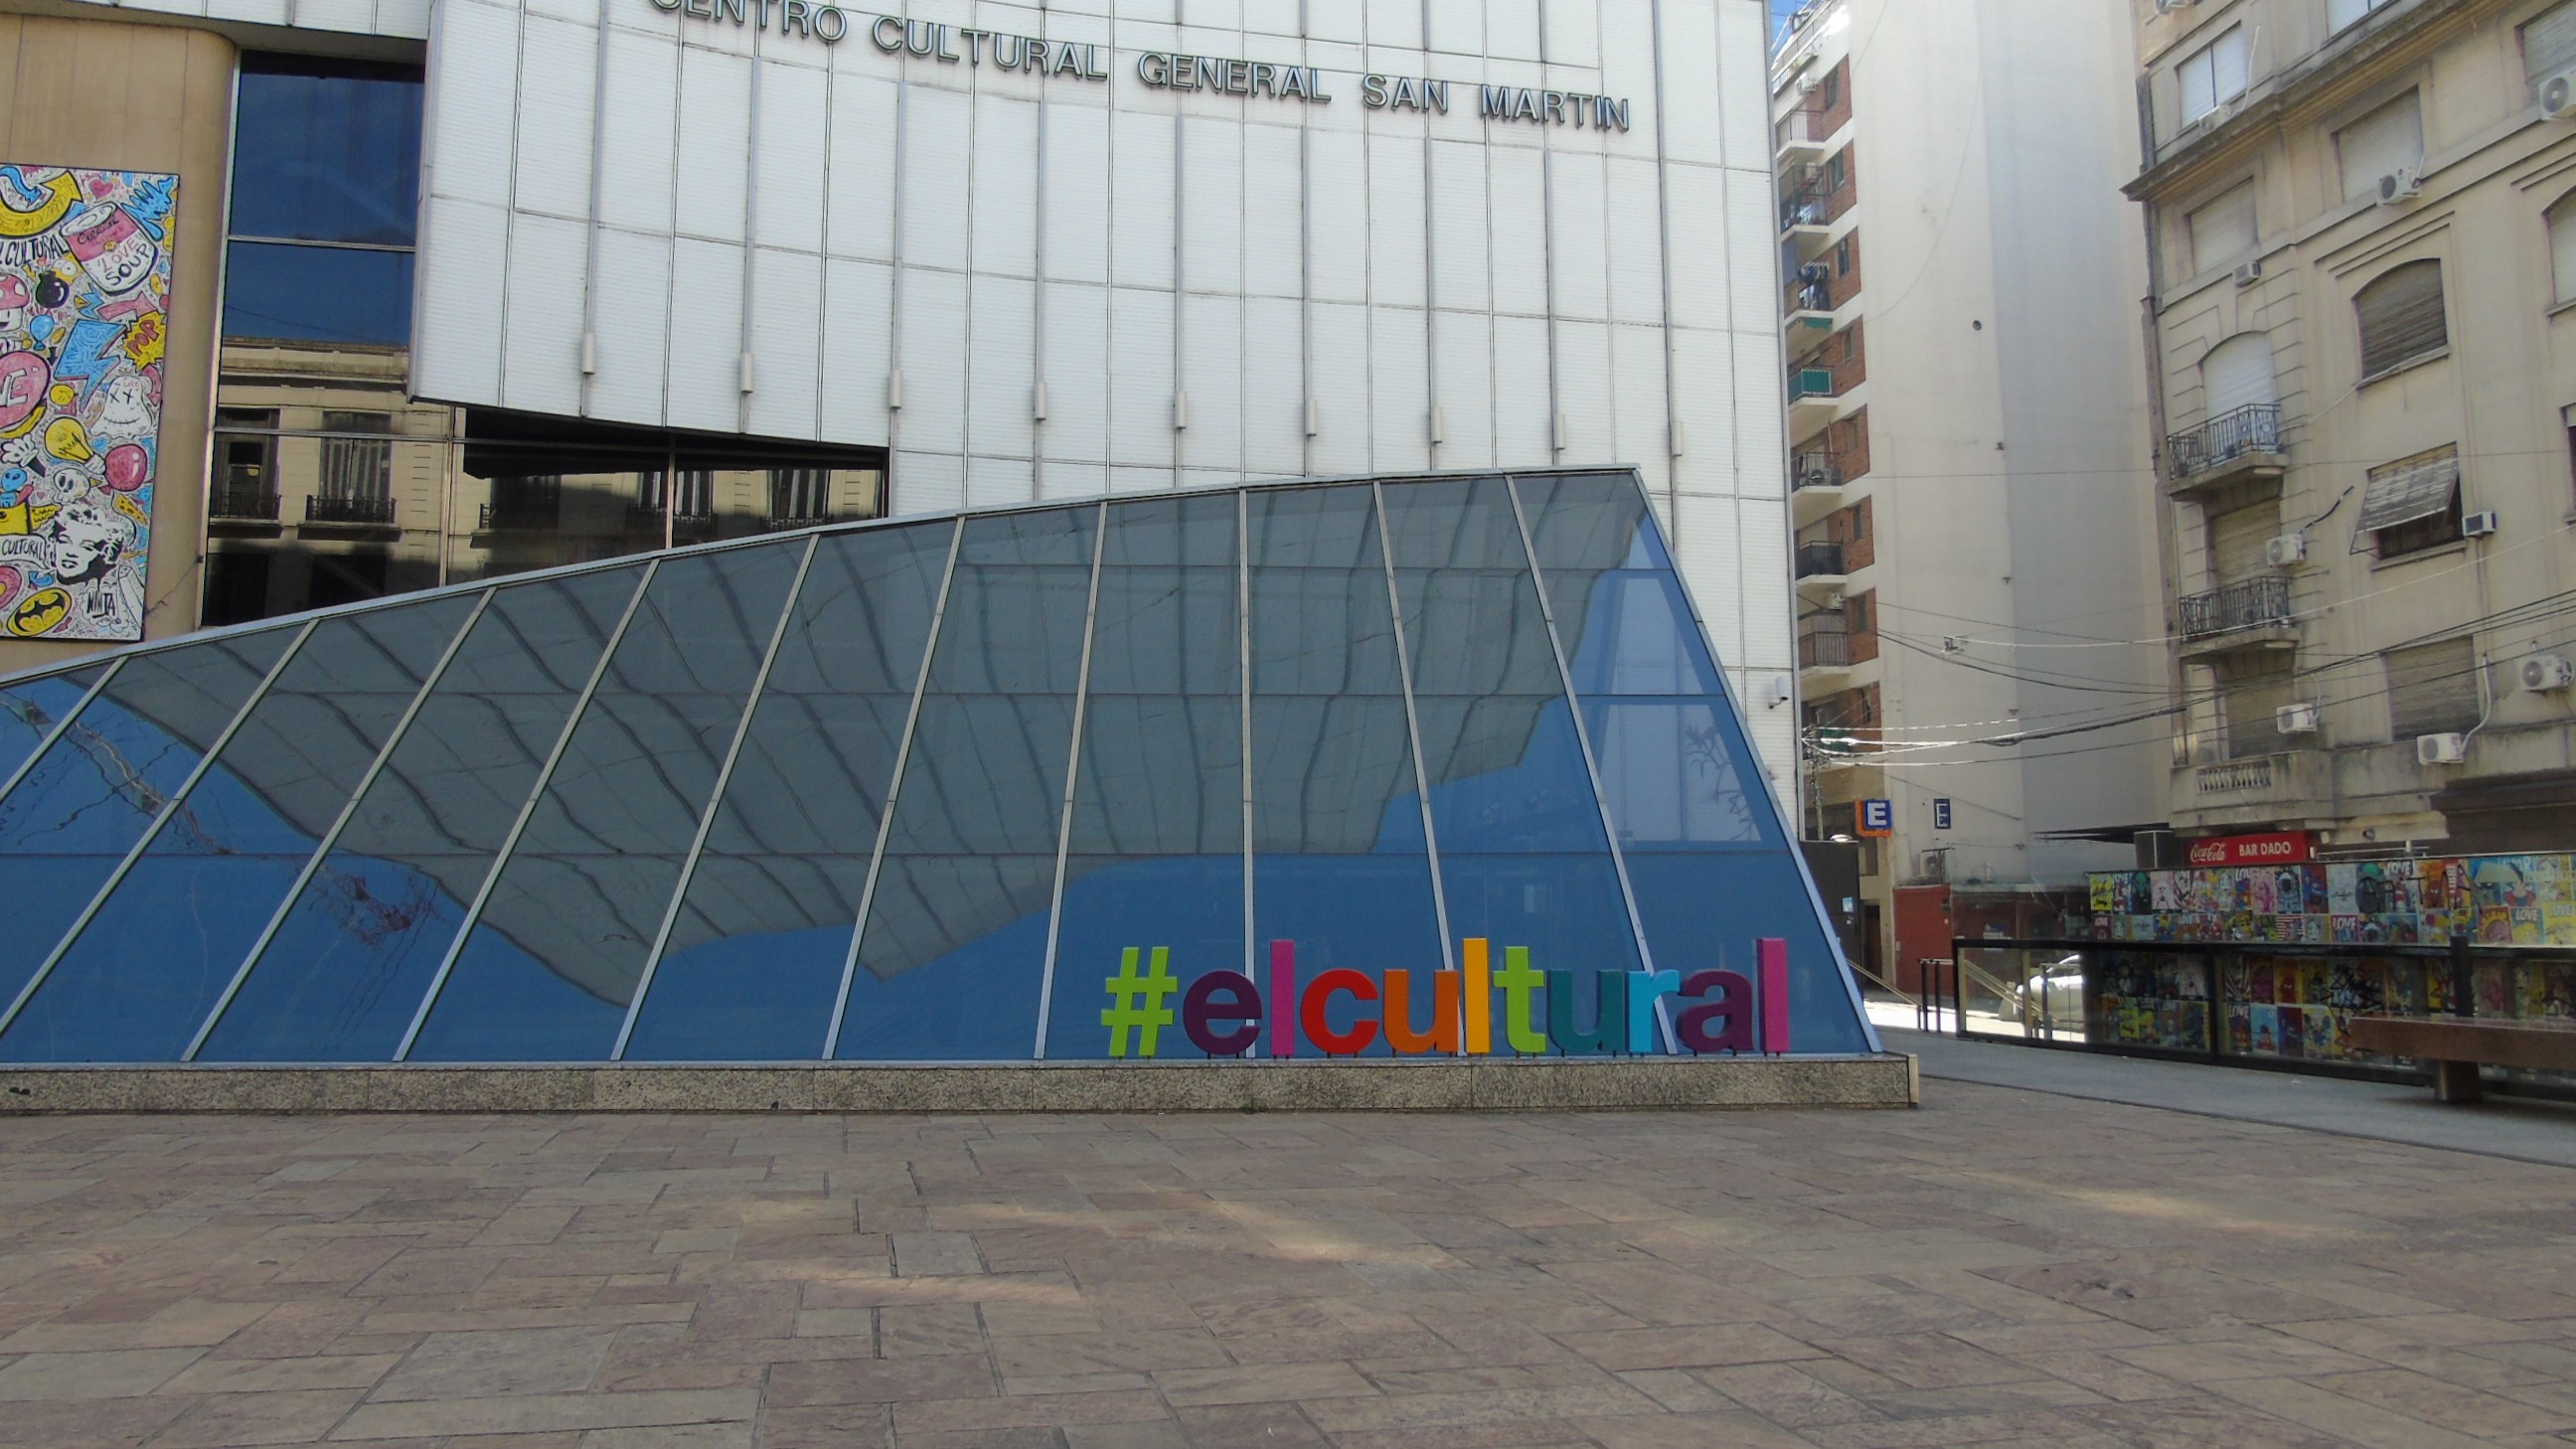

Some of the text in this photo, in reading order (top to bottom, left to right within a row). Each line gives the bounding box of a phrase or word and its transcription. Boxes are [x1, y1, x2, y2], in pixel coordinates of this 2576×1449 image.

[871, 15, 1109, 81] CULTURAL
[1137, 51, 1332, 102] GENERAL
[1362, 74, 1449, 115] SAN
[1480, 83, 1630, 132] MARTIN
[5, 235, 69, 266] CULTURAL
[105, 243, 149, 285] SOUP
[126, 320, 159, 357] POP
[2, 539, 43, 561] CULTURAL
[1867, 802, 1886, 826] E
[1936, 803, 1948, 827] E
[2190, 842, 2291, 863] CocaCola BAR DADO
[2388, 861, 2412, 876] LOVE
[2094, 916, 2108, 926] LOVE
[2332, 916, 2356, 930] LOVE
[2515, 908, 2537, 921] LOVE
[1101, 937, 1789, 1057] #elcultural
[2229, 1005, 2249, 1019] LOVE
